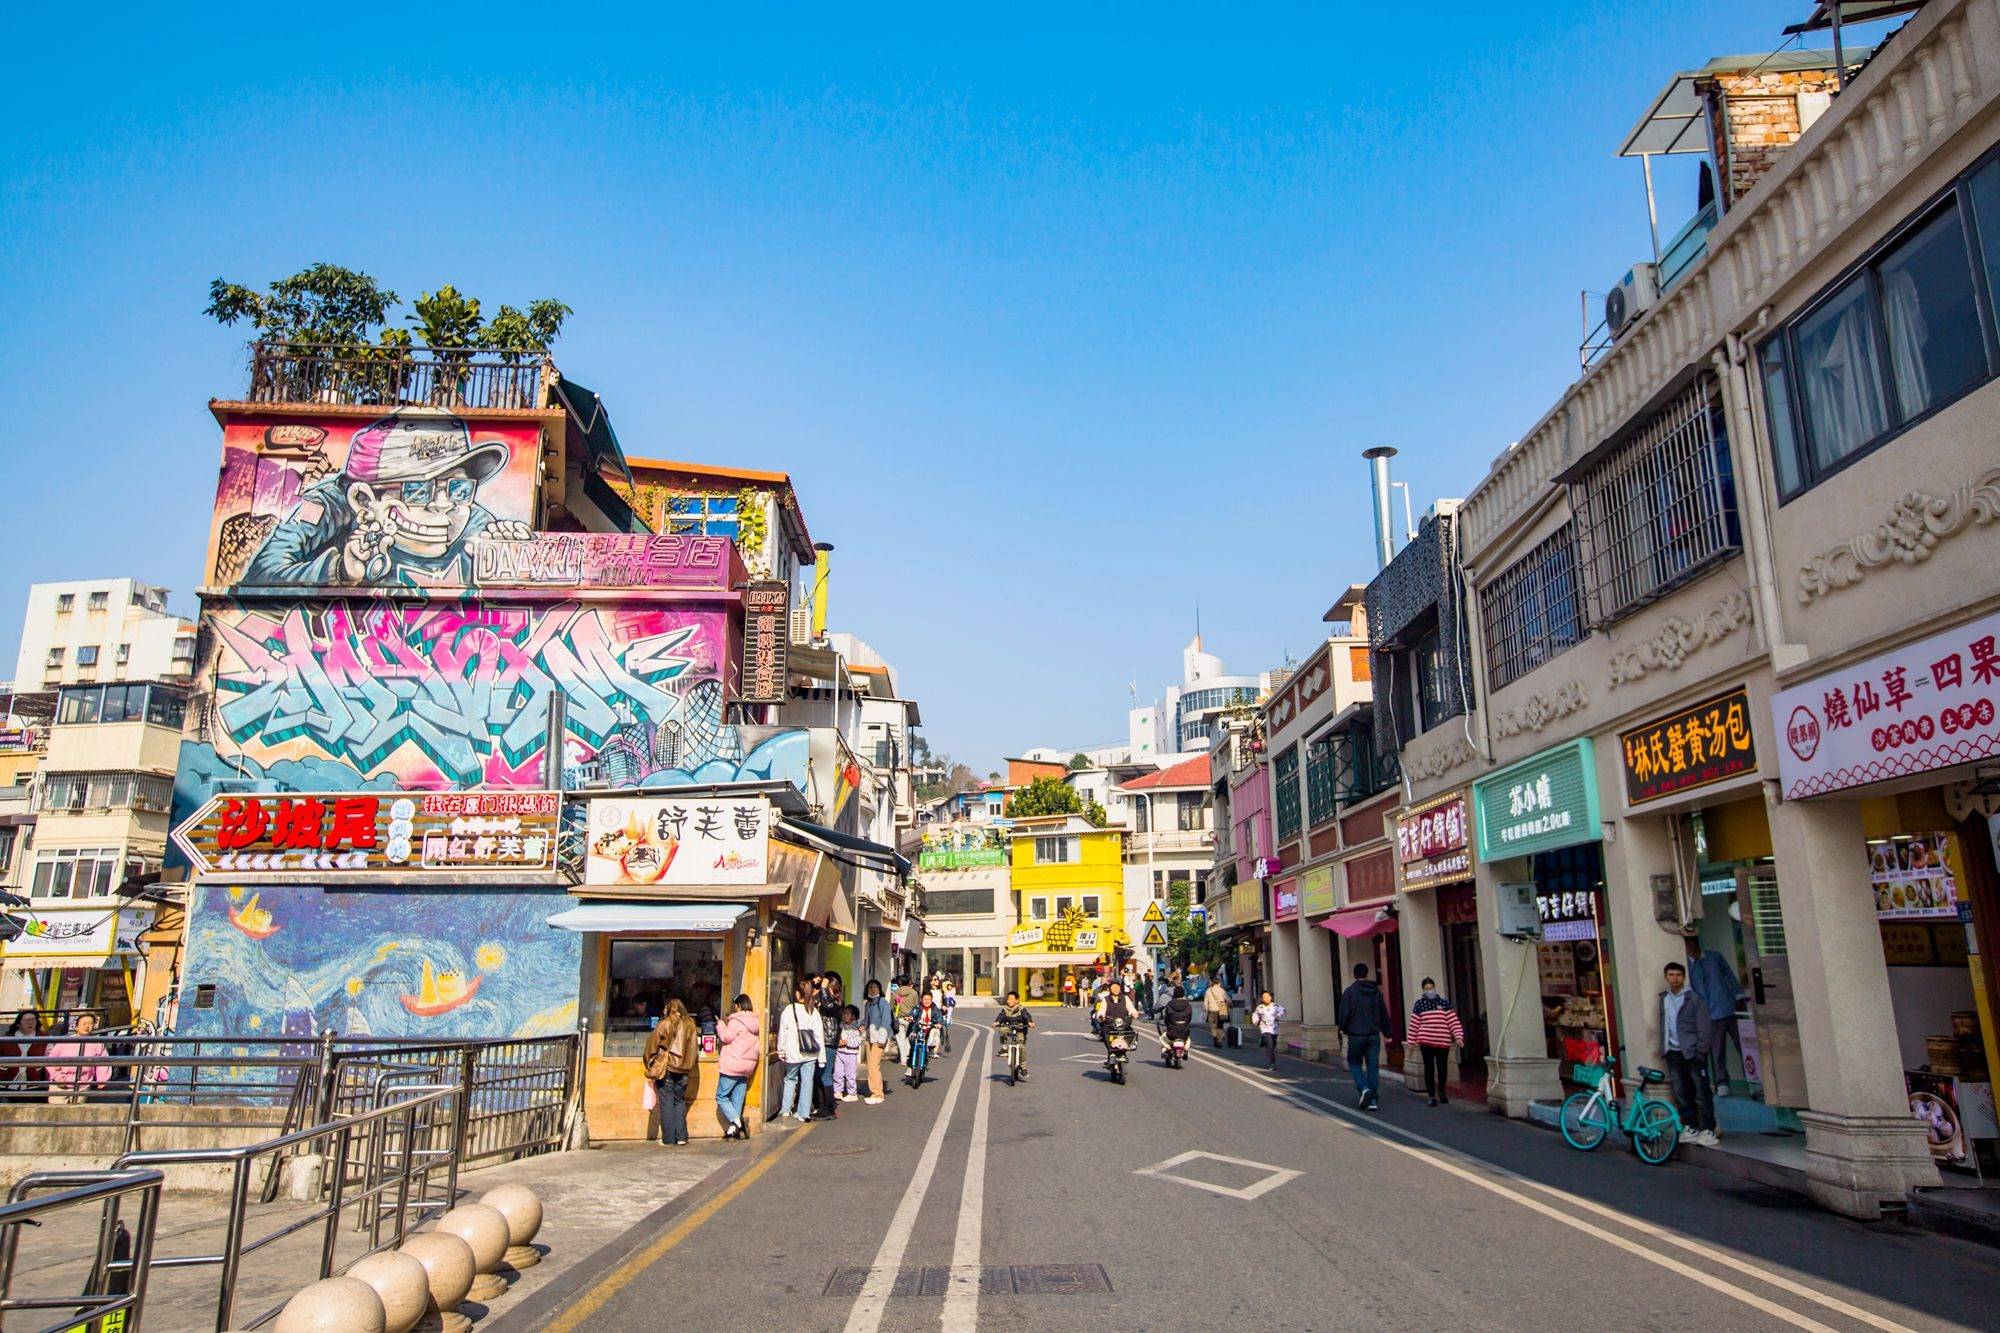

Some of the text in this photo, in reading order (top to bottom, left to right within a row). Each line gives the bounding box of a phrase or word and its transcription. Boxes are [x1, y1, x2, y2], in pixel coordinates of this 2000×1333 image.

[1823, 666, 1913, 732] 燒仙草
[1634, 701, 1750, 783] 林氏蟹黄汤包
[1874, 717, 1932, 750] 沙茶肉串
[423, 795, 557, 814] 我在厦门很想你
[1509, 773, 1552, 817] 苏小糖
[217, 796, 379, 849] 沙坡尾
[657, 805, 762, 842] 舒芙蕾
